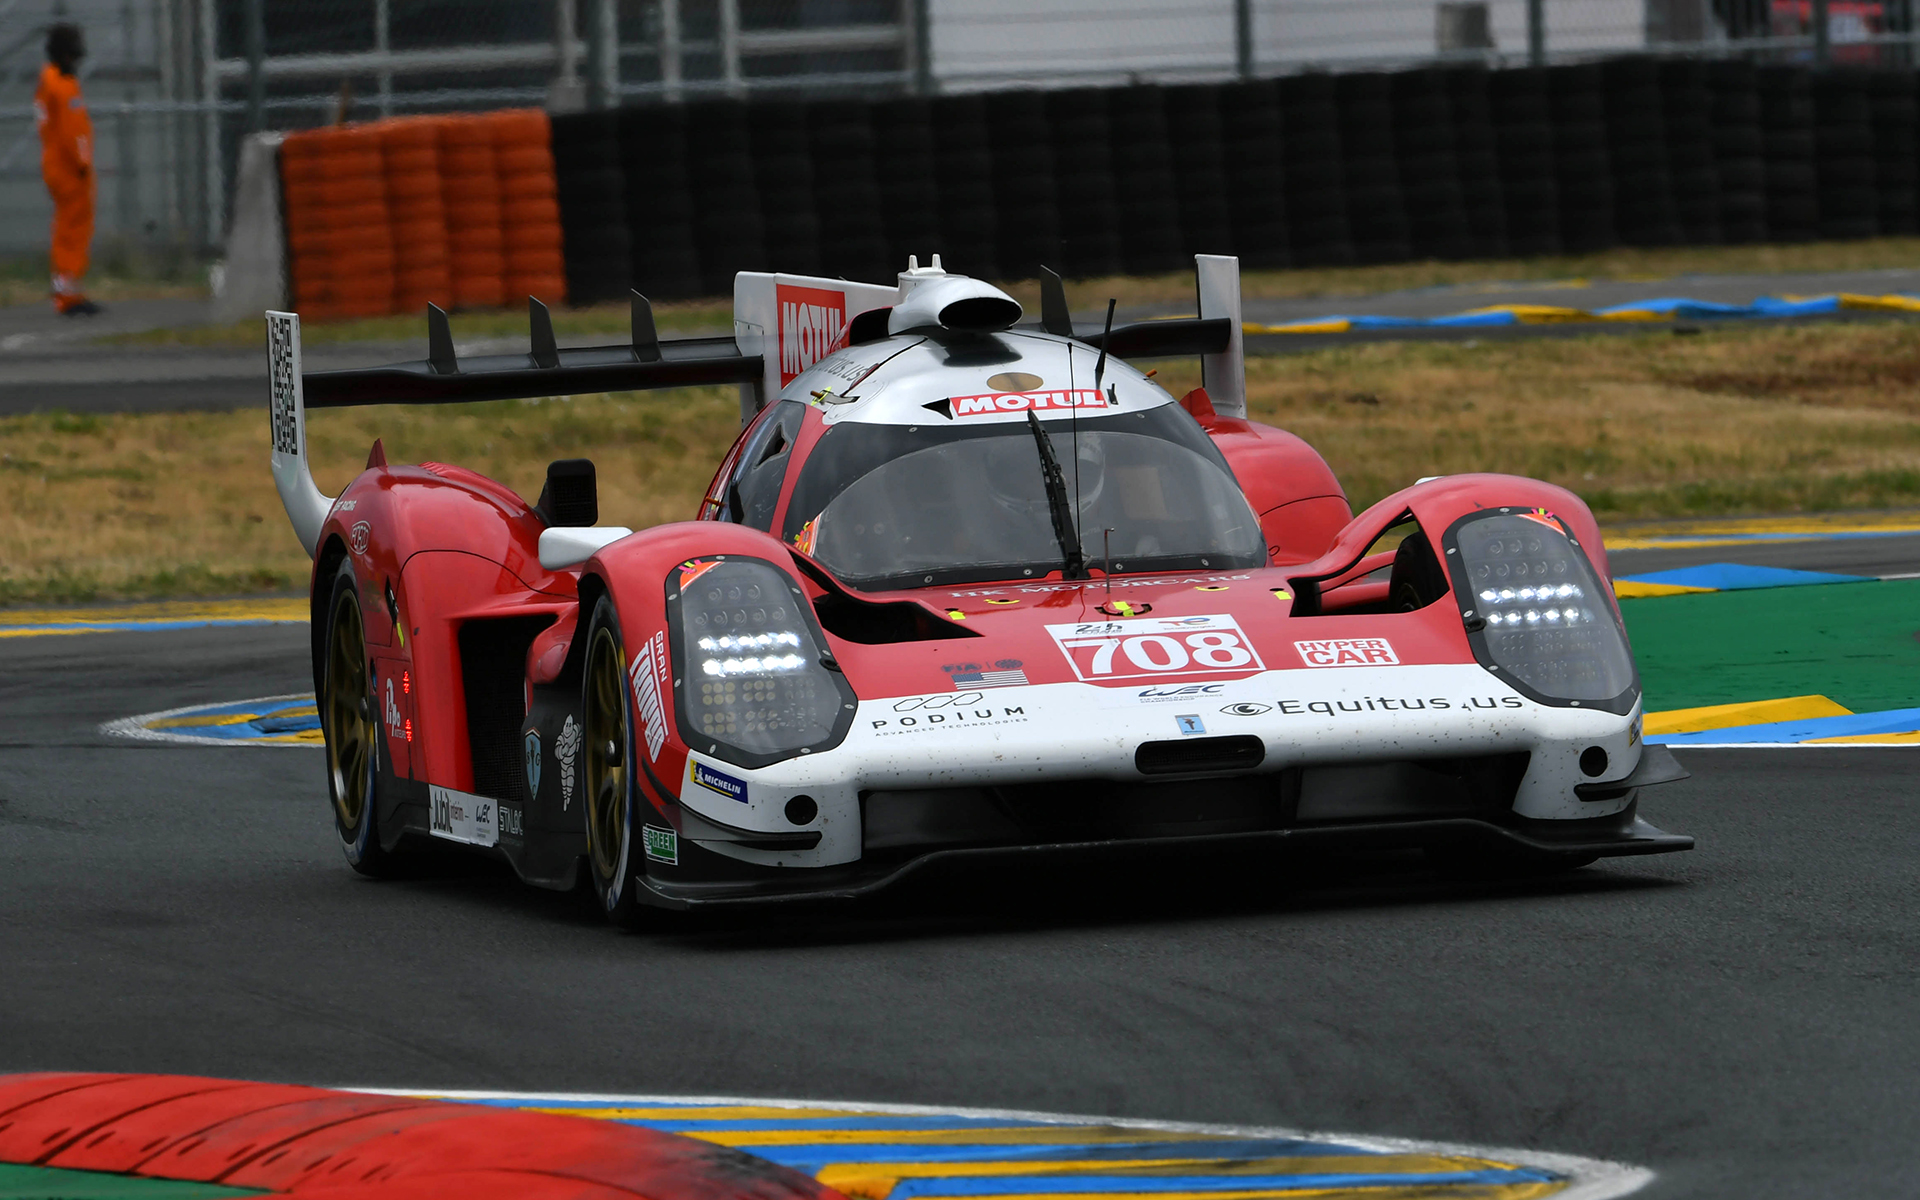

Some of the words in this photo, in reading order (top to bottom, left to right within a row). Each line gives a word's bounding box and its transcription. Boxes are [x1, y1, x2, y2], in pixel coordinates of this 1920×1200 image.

[958, 391, 1104, 414] MOTUL
[950, 590, 1008, 598] HK
[1021, 575, 1250, 593] MOTORCARS
[655, 630, 668, 682] GRAN
[1063, 632, 1251, 675] 708
[1300, 640, 1385, 651] HYPER
[1305, 649, 1394, 665] CAR
[1138, 684, 1225, 697] WEC
[629, 641, 665, 763] TROFEO
[872, 706, 1025, 729] PODIUM
[875, 727, 935, 737] ADVANCED
[941, 718, 1028, 729] TECHNOLOGIES
[704, 774, 741, 794] MICHELIN
[647, 830, 675, 851] GREEN
